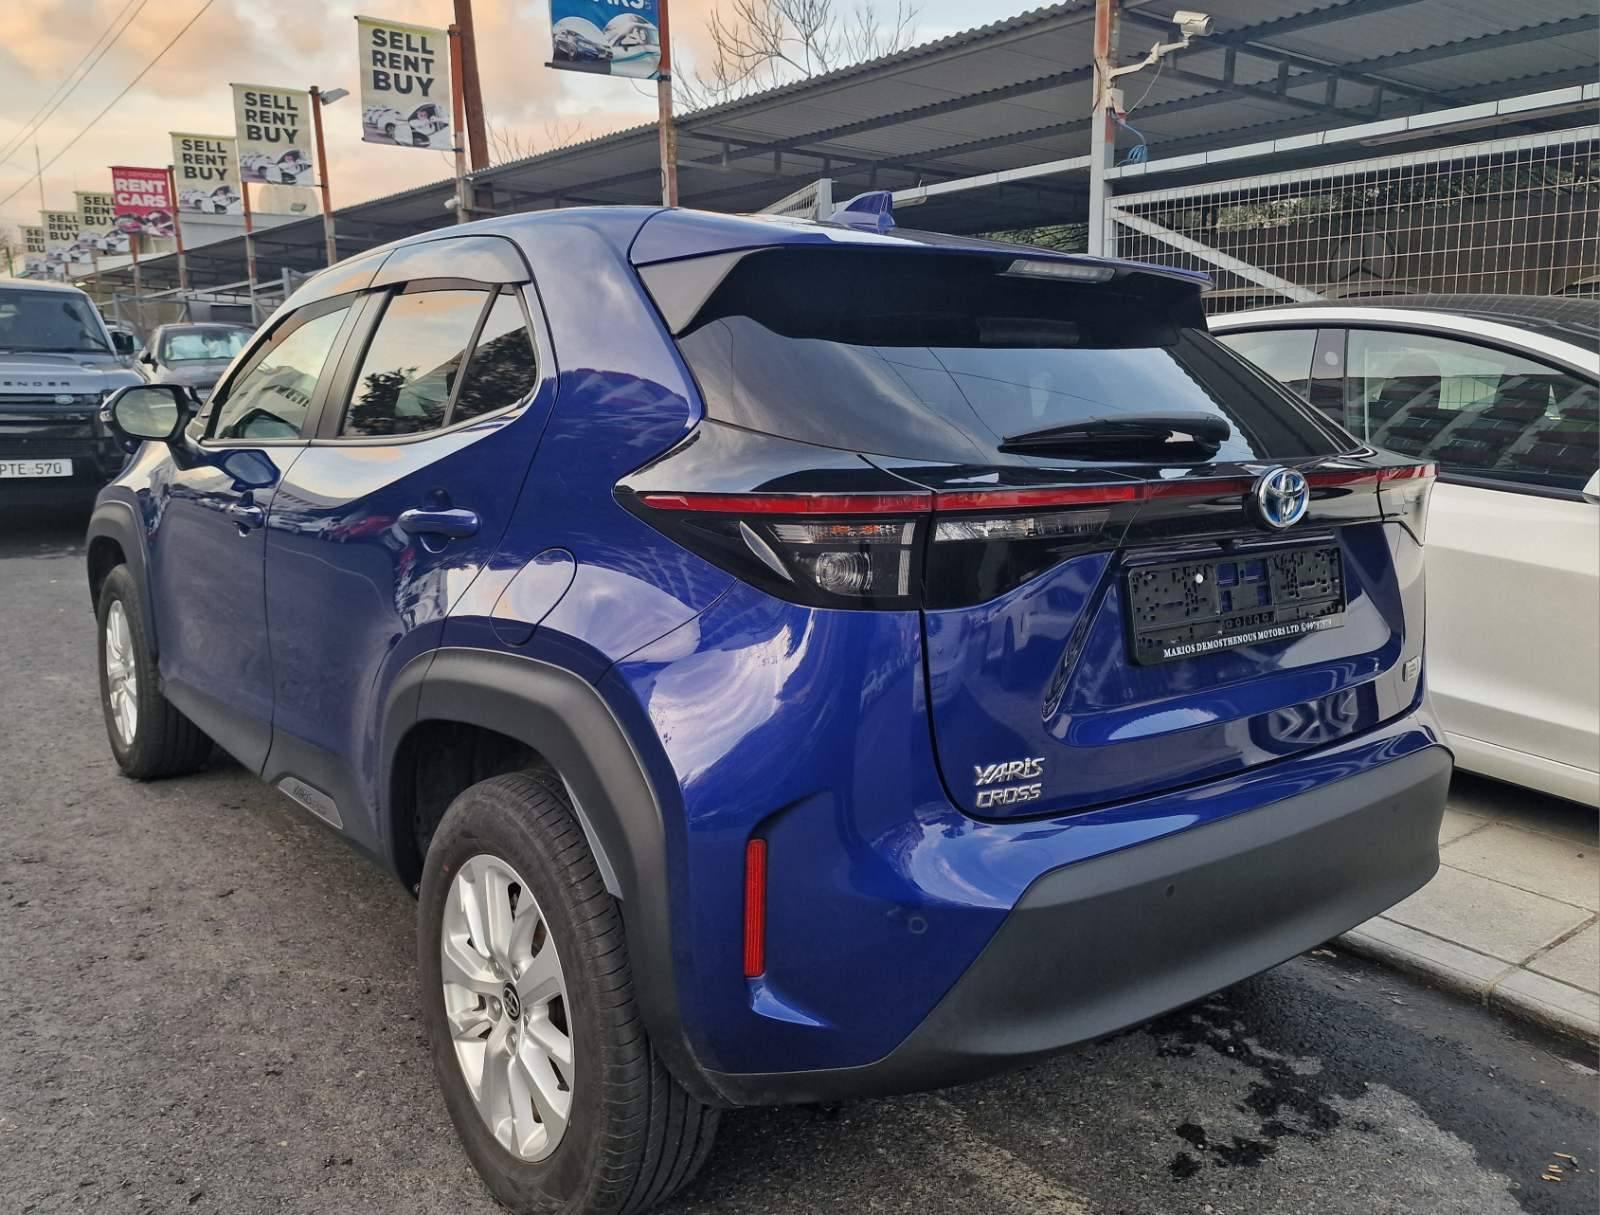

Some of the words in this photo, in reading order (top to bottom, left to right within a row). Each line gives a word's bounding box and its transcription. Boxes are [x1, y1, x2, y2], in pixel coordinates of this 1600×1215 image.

[372, 28, 434, 55] SELL
[372, 49, 434, 75] RENT
[373, 69, 434, 97] BUY
[244, 92, 298, 111] SELL
[245, 109, 298, 126] RENT
[247, 125, 298, 144] BUY
[182, 139, 227, 153] SELL
[182, 153, 227, 166] RENT
[184, 166, 228, 181] BUY
[115, 178, 166, 193] RENT
[117, 193, 166, 207] CARS
[48, 214, 79, 223] SELL
[49, 224, 79, 232] RENT
[50, 232, 79, 241] BUY
[28, 245, 46, 253] BU
[0, 463, 27, 475] PTE
[35, 462, 62, 474] 570
[1163, 643, 1196, 658] MARIOS
[1196, 631, 1257, 652] DEMOSTHENOUS
[1257, 624, 1286, 640] MOTORS
[1285, 623, 1300, 634] LTD
[976, 783, 1042, 808] CROSS
